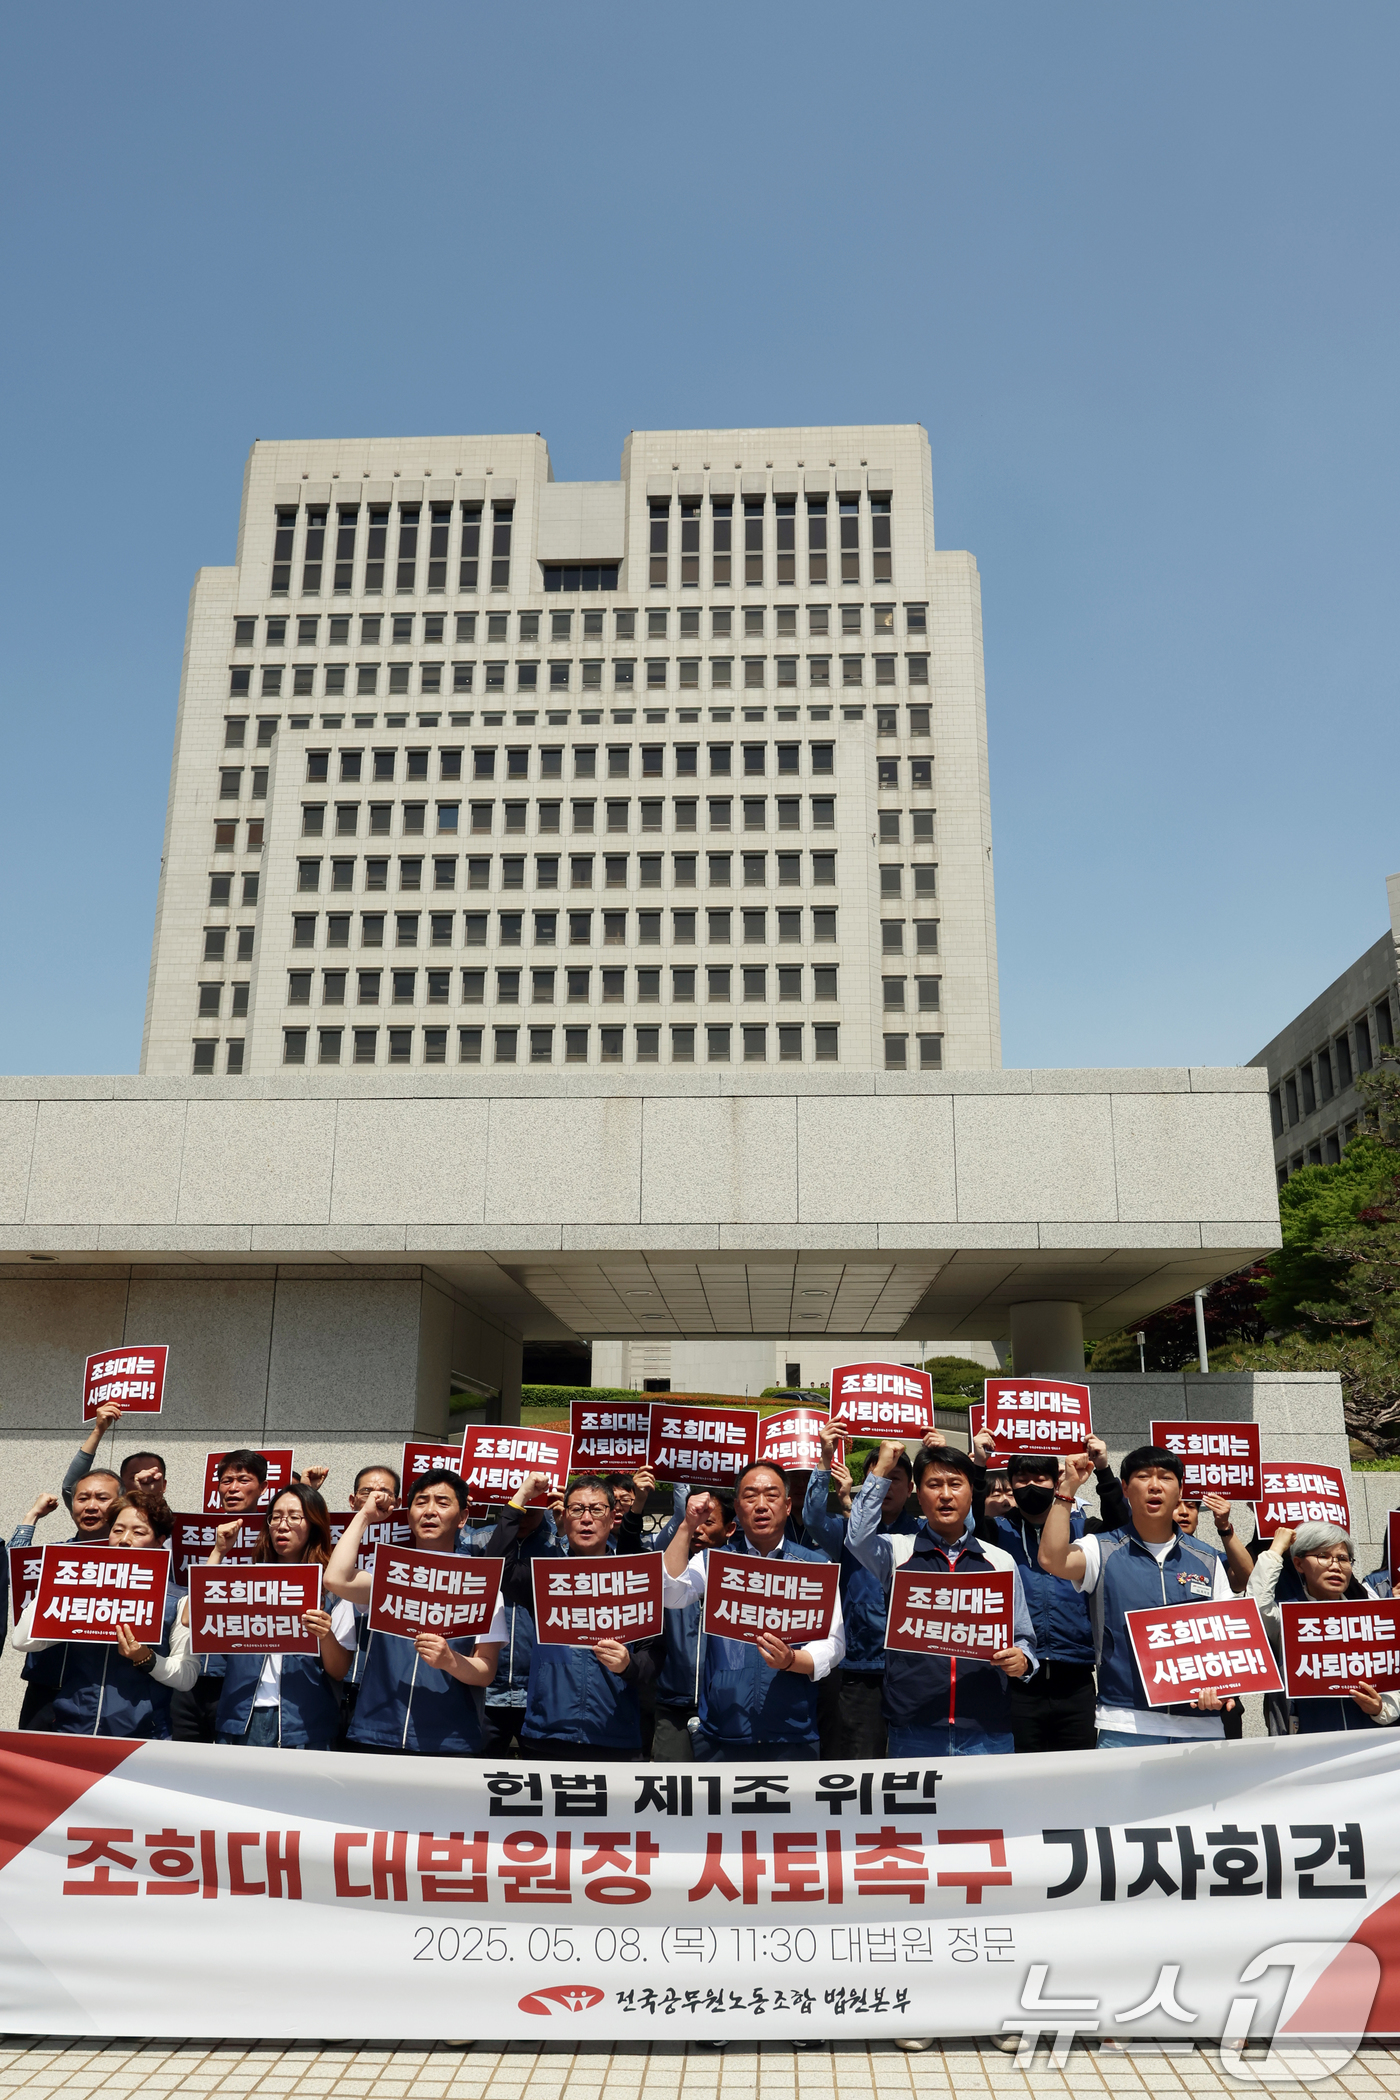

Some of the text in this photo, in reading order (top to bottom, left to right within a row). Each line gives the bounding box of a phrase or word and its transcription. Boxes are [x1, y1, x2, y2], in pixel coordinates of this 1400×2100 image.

[91, 1356, 155, 1382] 조희대는
[87, 1382, 155, 1406] 사퇴하라!
[841, 1373, 923, 1399] 조희대는
[837, 1401, 928, 1426] 사퇴하라!
[997, 1390, 1080, 1414] 조희대는
[581, 1412, 649, 1432] 조희대는
[661, 1417, 747, 1445] 조희대는
[994, 1418, 1086, 1443] 사퇴하라!
[475, 1438, 559, 1465] 조희대는
[762, 1441, 838, 1463] 사퇴하!
[1166, 1433, 1250, 1456] 조희대는
[654, 1448, 748, 1473] 사퇴하라!
[467, 1467, 559, 1492] 사퇴하!
[1183, 1464, 1254, 1487] 퇴하라!
[1263, 1473, 1338, 1497] 조희대는
[1264, 1501, 1347, 1526] 사퇴하라!
[330, 1522, 411, 1545] 조대는
[54, 1560, 154, 1590] 조희대는
[386, 1560, 487, 1595] 조희대는
[548, 1570, 650, 1597] 조희대는
[720, 1566, 823, 1601] 조희대는
[203, 1580, 304, 1606] 조희대는
[906, 1586, 1005, 1614] 조희대는
[43, 1596, 154, 1626] 사퇴하라!
[379, 1594, 486, 1627] 사퇴하라!
[546, 1601, 654, 1631] 사퇴하라!
[713, 1599, 824, 1632] 사퇴하라!
[897, 1618, 1008, 1649] 사퇴하라!
[1148, 1615, 1251, 1650] 조희대는
[1297, 1615, 1395, 1642] 조희대는
[1153, 1649, 1268, 1685] 사퇴하라!
[1295, 1650, 1400, 1679] 사퇴하라!
[483, 1770, 942, 1817] 헌법 제1조 위반
[61, 1822, 1368, 1905] 조희대 대법원장 사퇴촉구 기자회견
[413, 1927, 515, 1963] 2025.
[527, 1927, 581, 1963] 05.
[731, 1927, 817, 1963] 11:30
[832, 1927, 933, 1964] 대법원
[948, 1927, 1016, 1964] 정문
[616, 1986, 912, 2016] 전국공무원노동조합 법원본부
